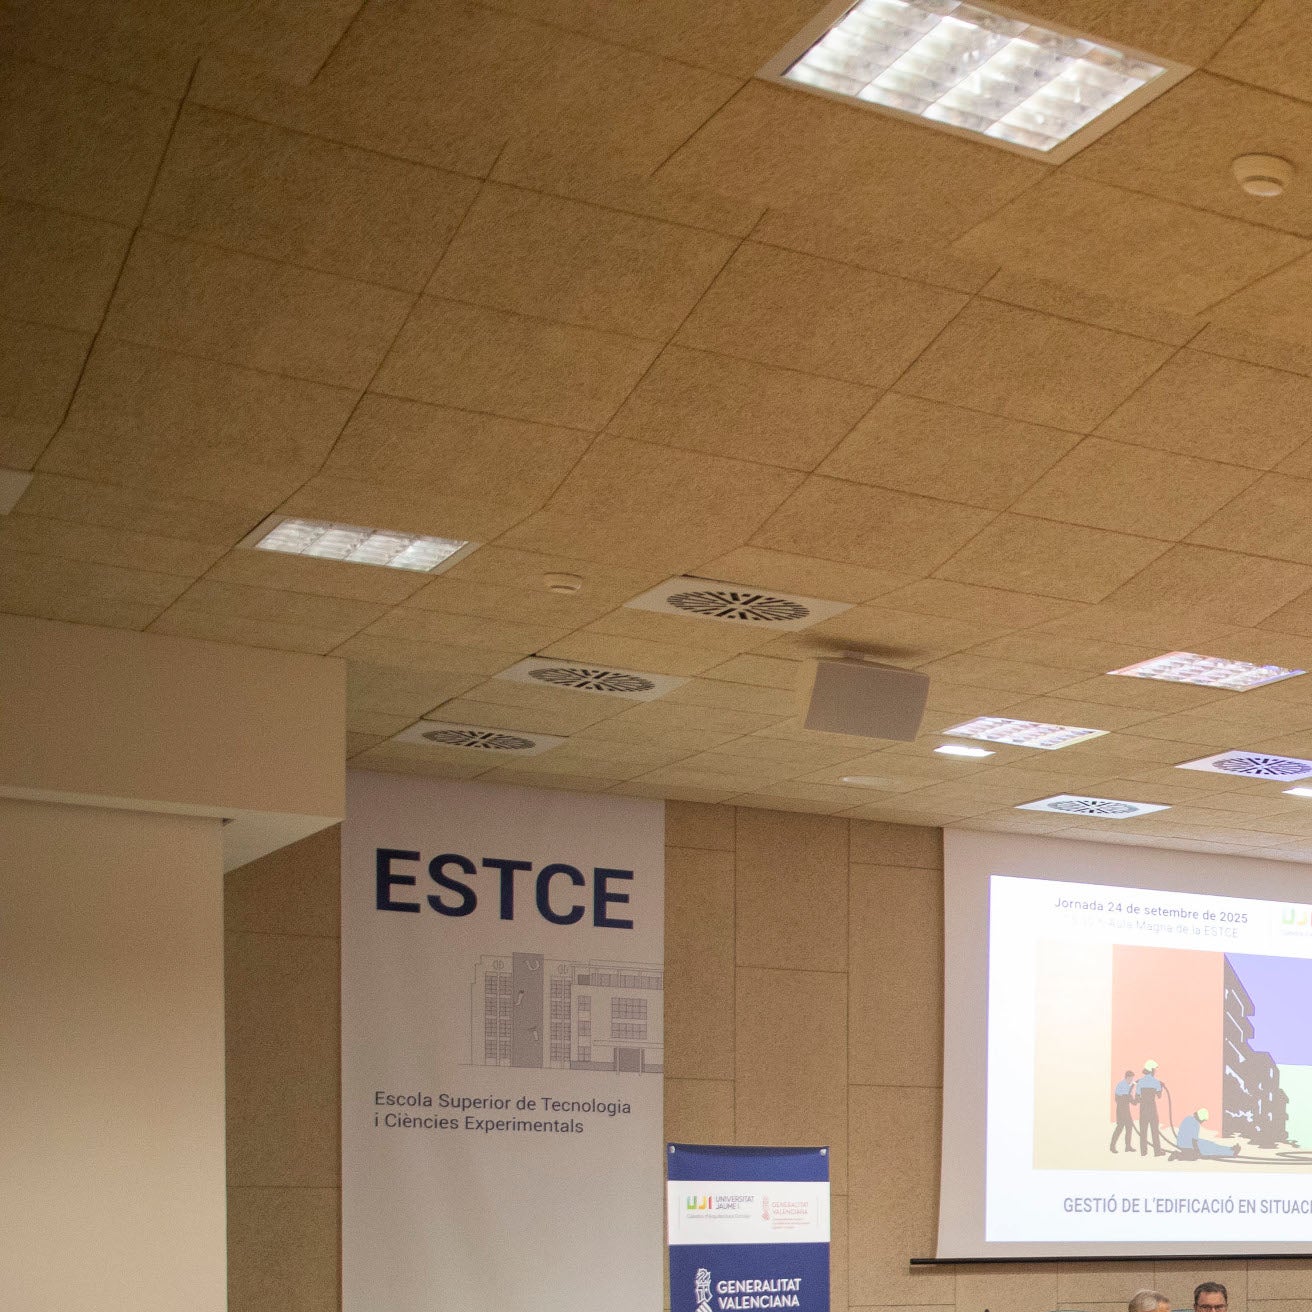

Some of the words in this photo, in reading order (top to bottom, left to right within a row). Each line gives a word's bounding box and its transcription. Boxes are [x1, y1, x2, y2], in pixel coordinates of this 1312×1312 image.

[375, 848, 634, 929] ESTCE
[1055, 897, 1104, 911] Jornada
[1107, 901, 1123, 912] 24
[1126, 903, 1140, 914] de
[1144, 905, 1199, 919] setembre
[1202, 909, 1216, 921] de
[1219, 911, 1248, 923] 2025
[1136, 919, 1173, 933] Magna
[1204, 925, 1239, 938] ESTCE
[374, 1091, 433, 1108] Escola
[438, 1093, 511, 1113] Superior
[516, 1095, 537, 1111] de
[541, 1097, 632, 1117] Tecnologia
[374, 1112, 379, 1127] i
[385, 1112, 459, 1130] Ciències
[465, 1115, 584, 1135] Experimentals
[715, 1195, 755, 1203] UNIVERSITAT
[715, 1202, 737, 1210] JAUME
[1063, 1194, 1118, 1213] GESTIÓ
[1122, 1198, 1141, 1213] DE
[1238, 1199, 1256, 1214] EN
[717, 1278, 802, 1294] GENERALITAT
[718, 1294, 800, 1310] VALENCIANA
